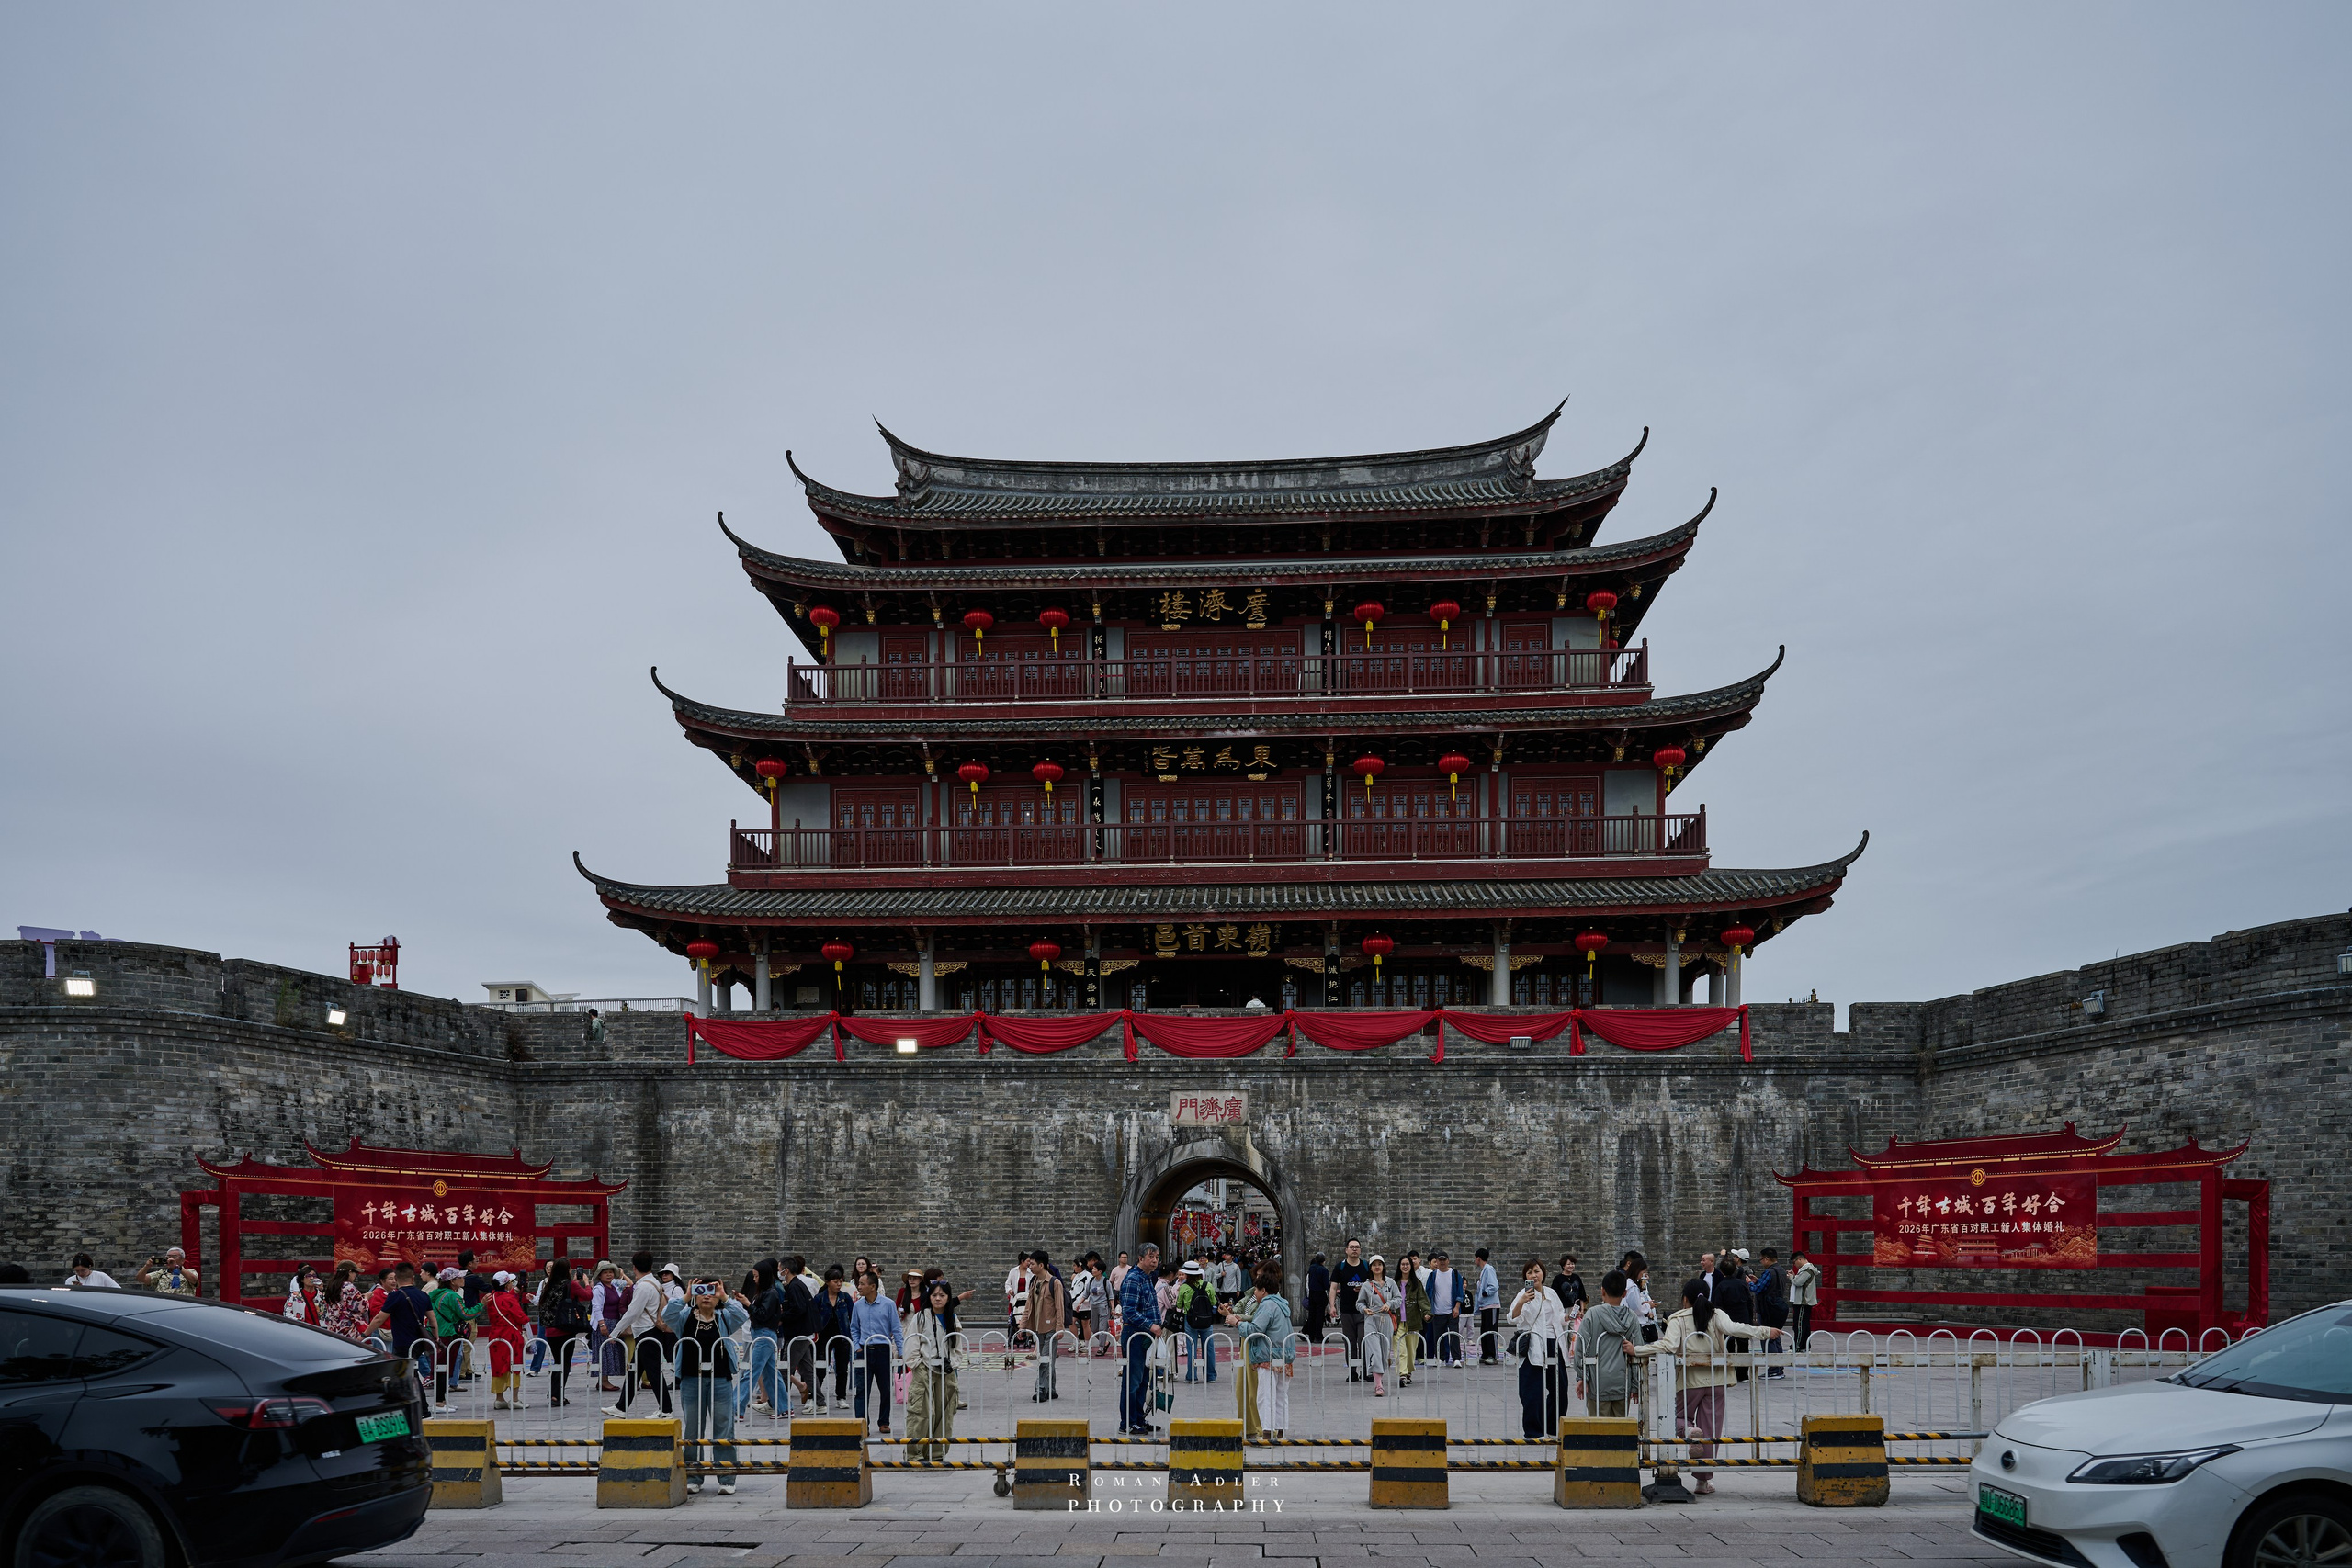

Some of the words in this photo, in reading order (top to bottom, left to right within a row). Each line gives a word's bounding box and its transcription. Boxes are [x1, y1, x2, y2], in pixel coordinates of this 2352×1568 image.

[1159, 588, 1271, 621] 廣濟樓
[1155, 922, 1272, 952] 嶺東首邑
[1176, 1096, 1242, 1122] 廣濟門
[363, 1230, 514, 1242] 2026年广东省百对职工新人集体婚礼
[1899, 1221, 2065, 1235] 2026年广东省百对职工新人集体婚礼
